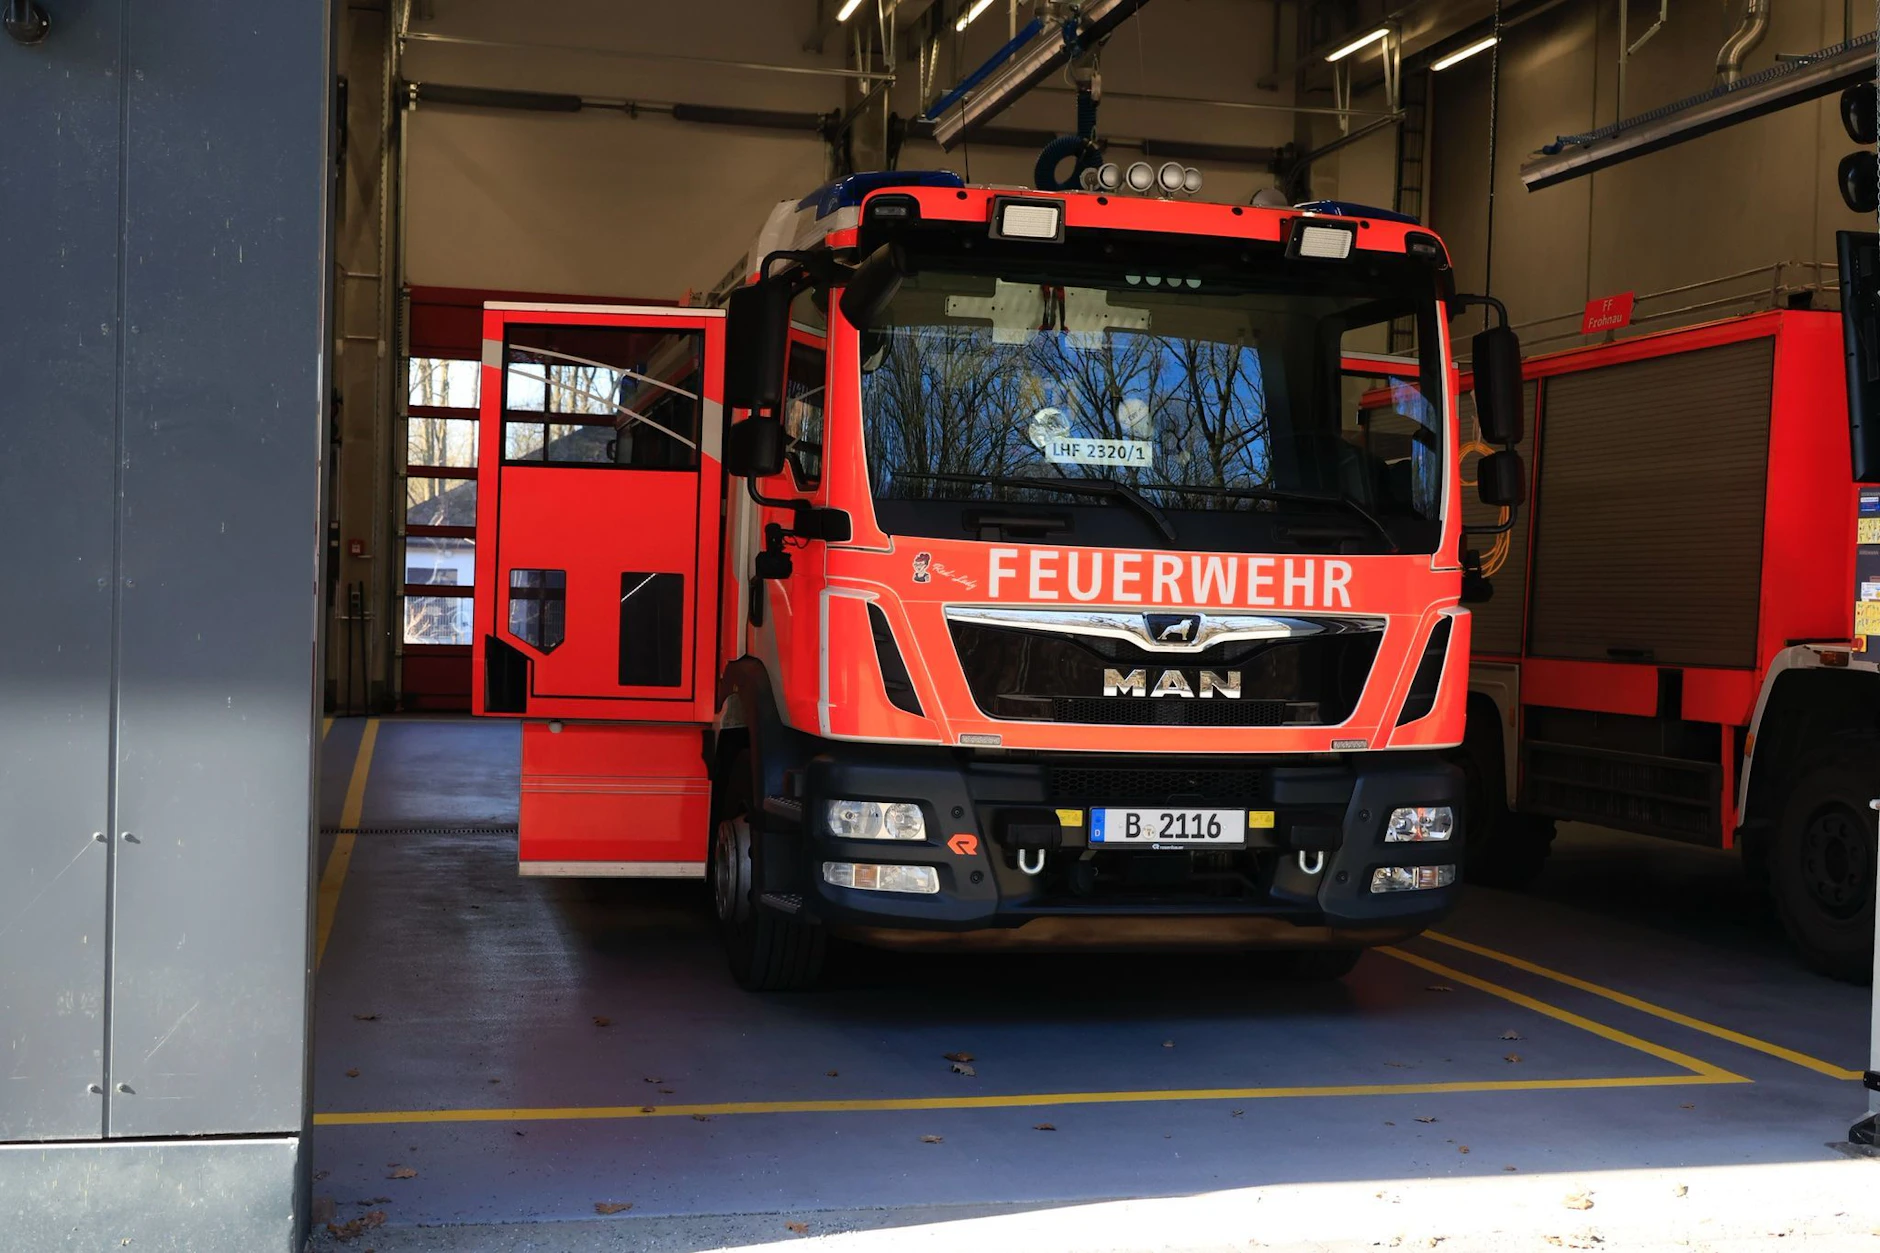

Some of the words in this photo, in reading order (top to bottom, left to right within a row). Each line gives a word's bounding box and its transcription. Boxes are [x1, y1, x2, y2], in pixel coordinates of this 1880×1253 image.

[1602, 299, 1614, 312] FF
[1588, 314, 1622, 328] Frohnau
[1053, 443, 1080, 457] LHF
[1087, 445, 1145, 461] 2320/1
[989, 548, 1352, 608] FEUERWEHR
[1103, 667, 1242, 699] MAN
[1125, 813, 1141, 839] B
[1159, 813, 1222, 839] 2116
